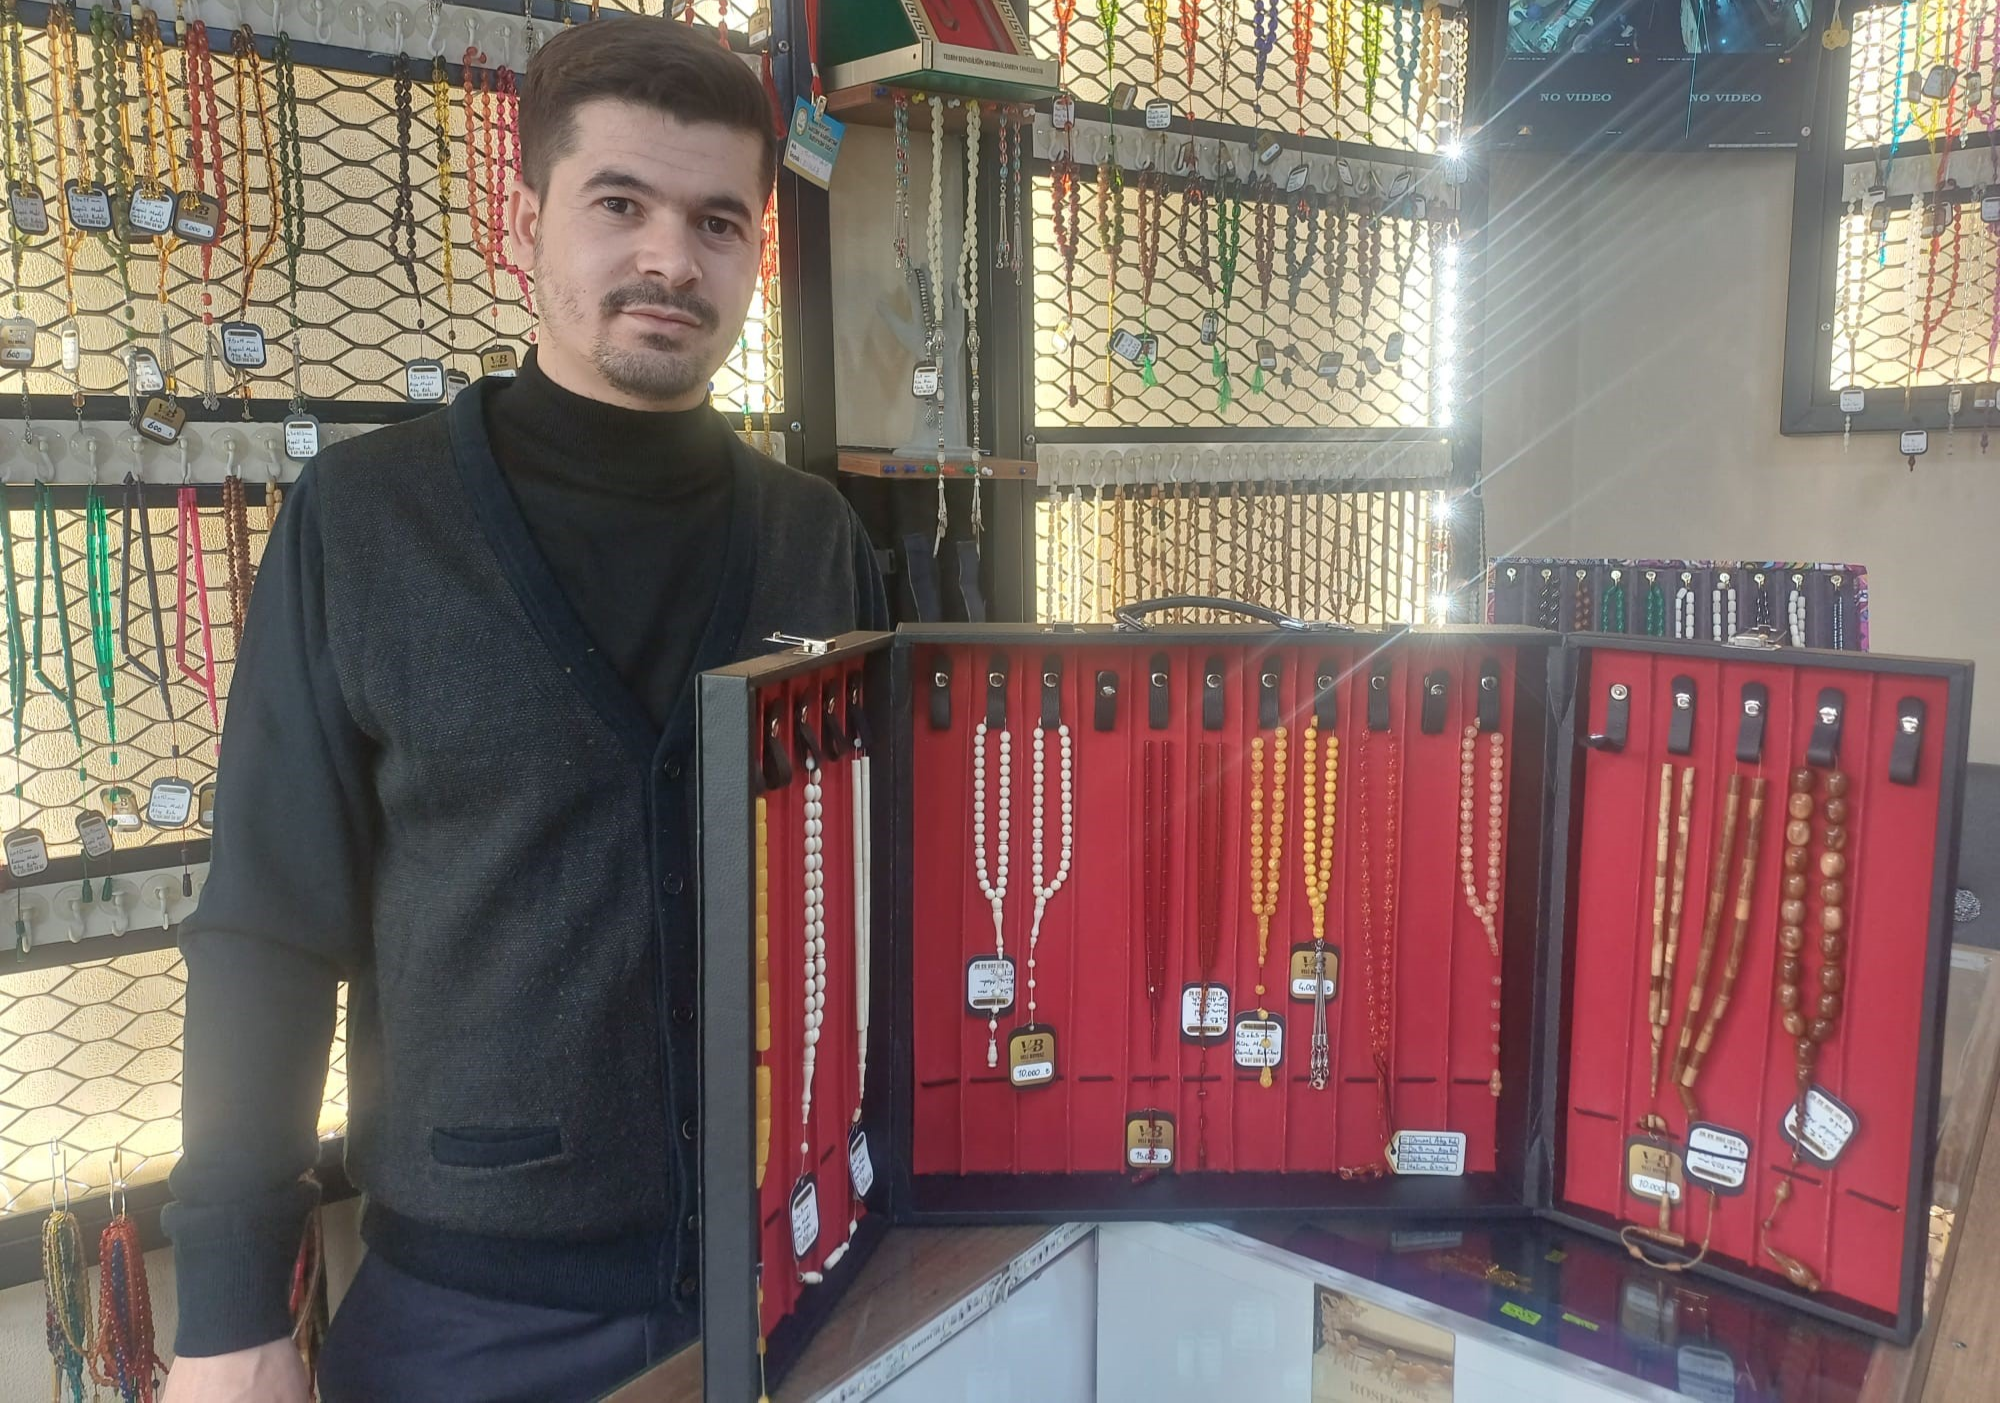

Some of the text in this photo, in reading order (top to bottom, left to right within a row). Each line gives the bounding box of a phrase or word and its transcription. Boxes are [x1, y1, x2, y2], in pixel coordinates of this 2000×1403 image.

[1540, 93, 1612, 102] NO VIDEO
[1690, 94, 1762, 102] NO VIDEO
[6, 349, 20, 358] 600
[147, 421, 162, 433] 600
